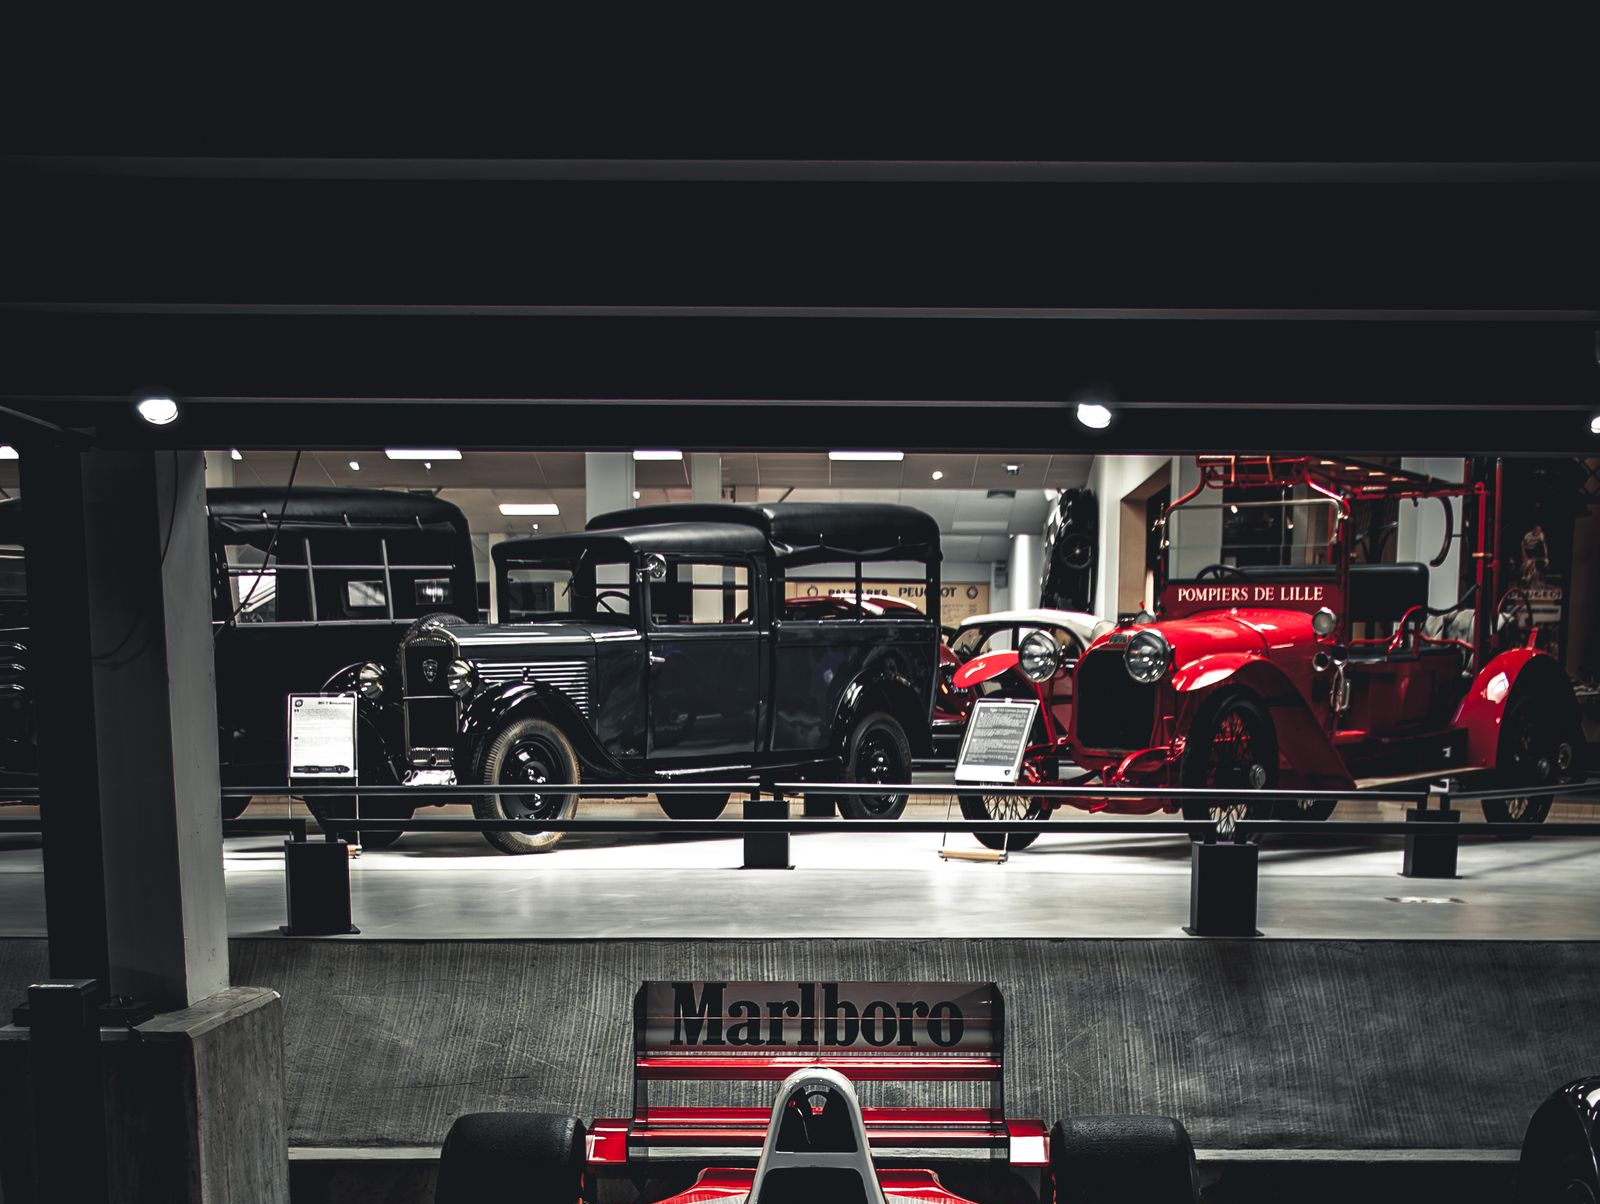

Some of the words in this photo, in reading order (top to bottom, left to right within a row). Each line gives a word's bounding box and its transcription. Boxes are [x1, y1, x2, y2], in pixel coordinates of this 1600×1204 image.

[899, 586, 957, 598] PEUOT
[1178, 587, 1248, 602] POMPIERS
[1254, 587, 1274, 601] DE
[1281, 586, 1323, 601] LILLE
[670, 983, 965, 1047] Marlboro
